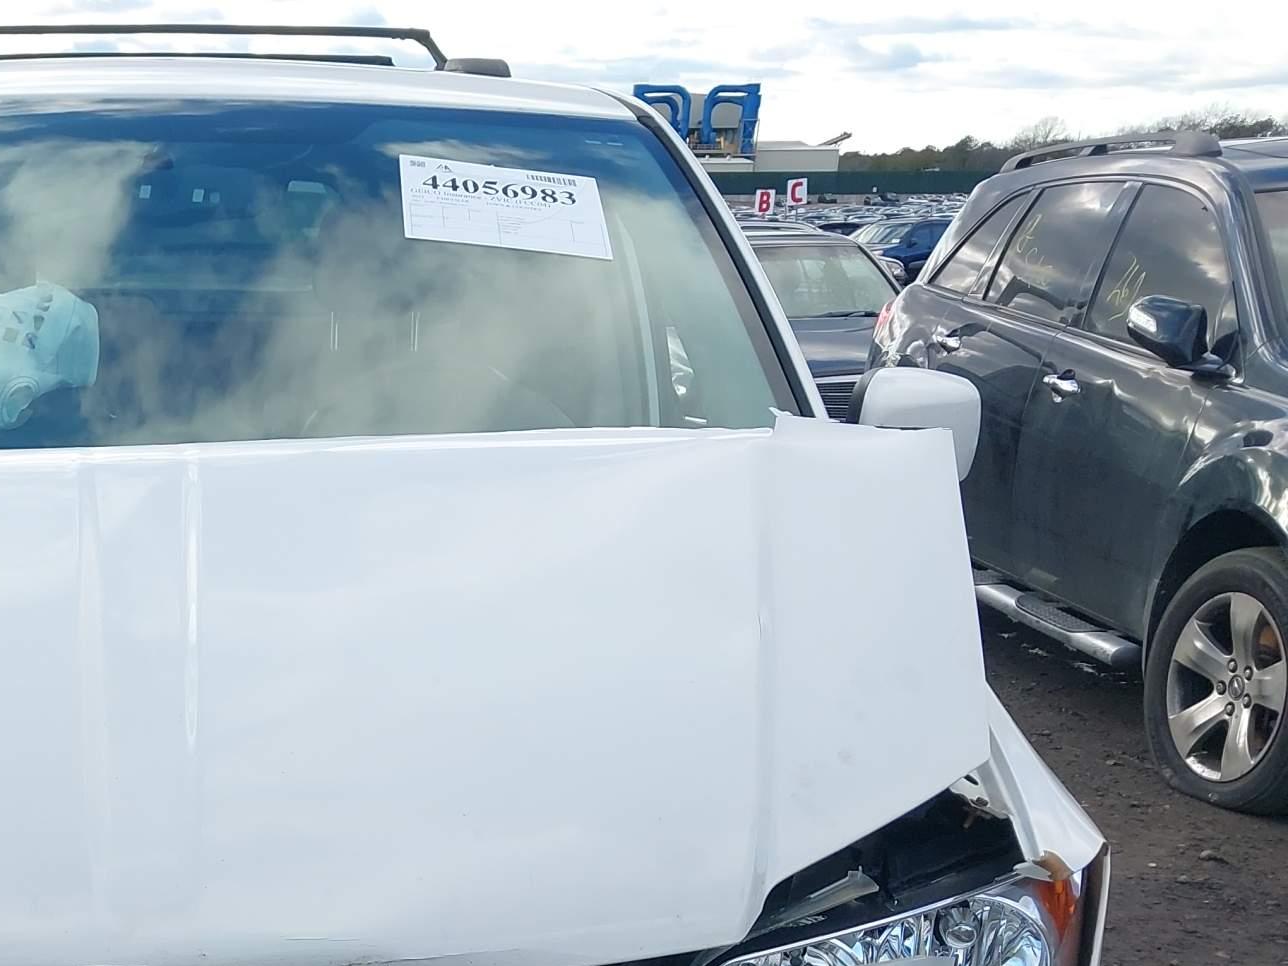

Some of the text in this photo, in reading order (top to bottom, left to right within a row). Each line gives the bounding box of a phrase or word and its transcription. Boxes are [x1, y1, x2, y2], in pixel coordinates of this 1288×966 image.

[421, 174, 577, 206] 44056983
[791, 181, 803, 203] C
[758, 191, 771, 212] B
